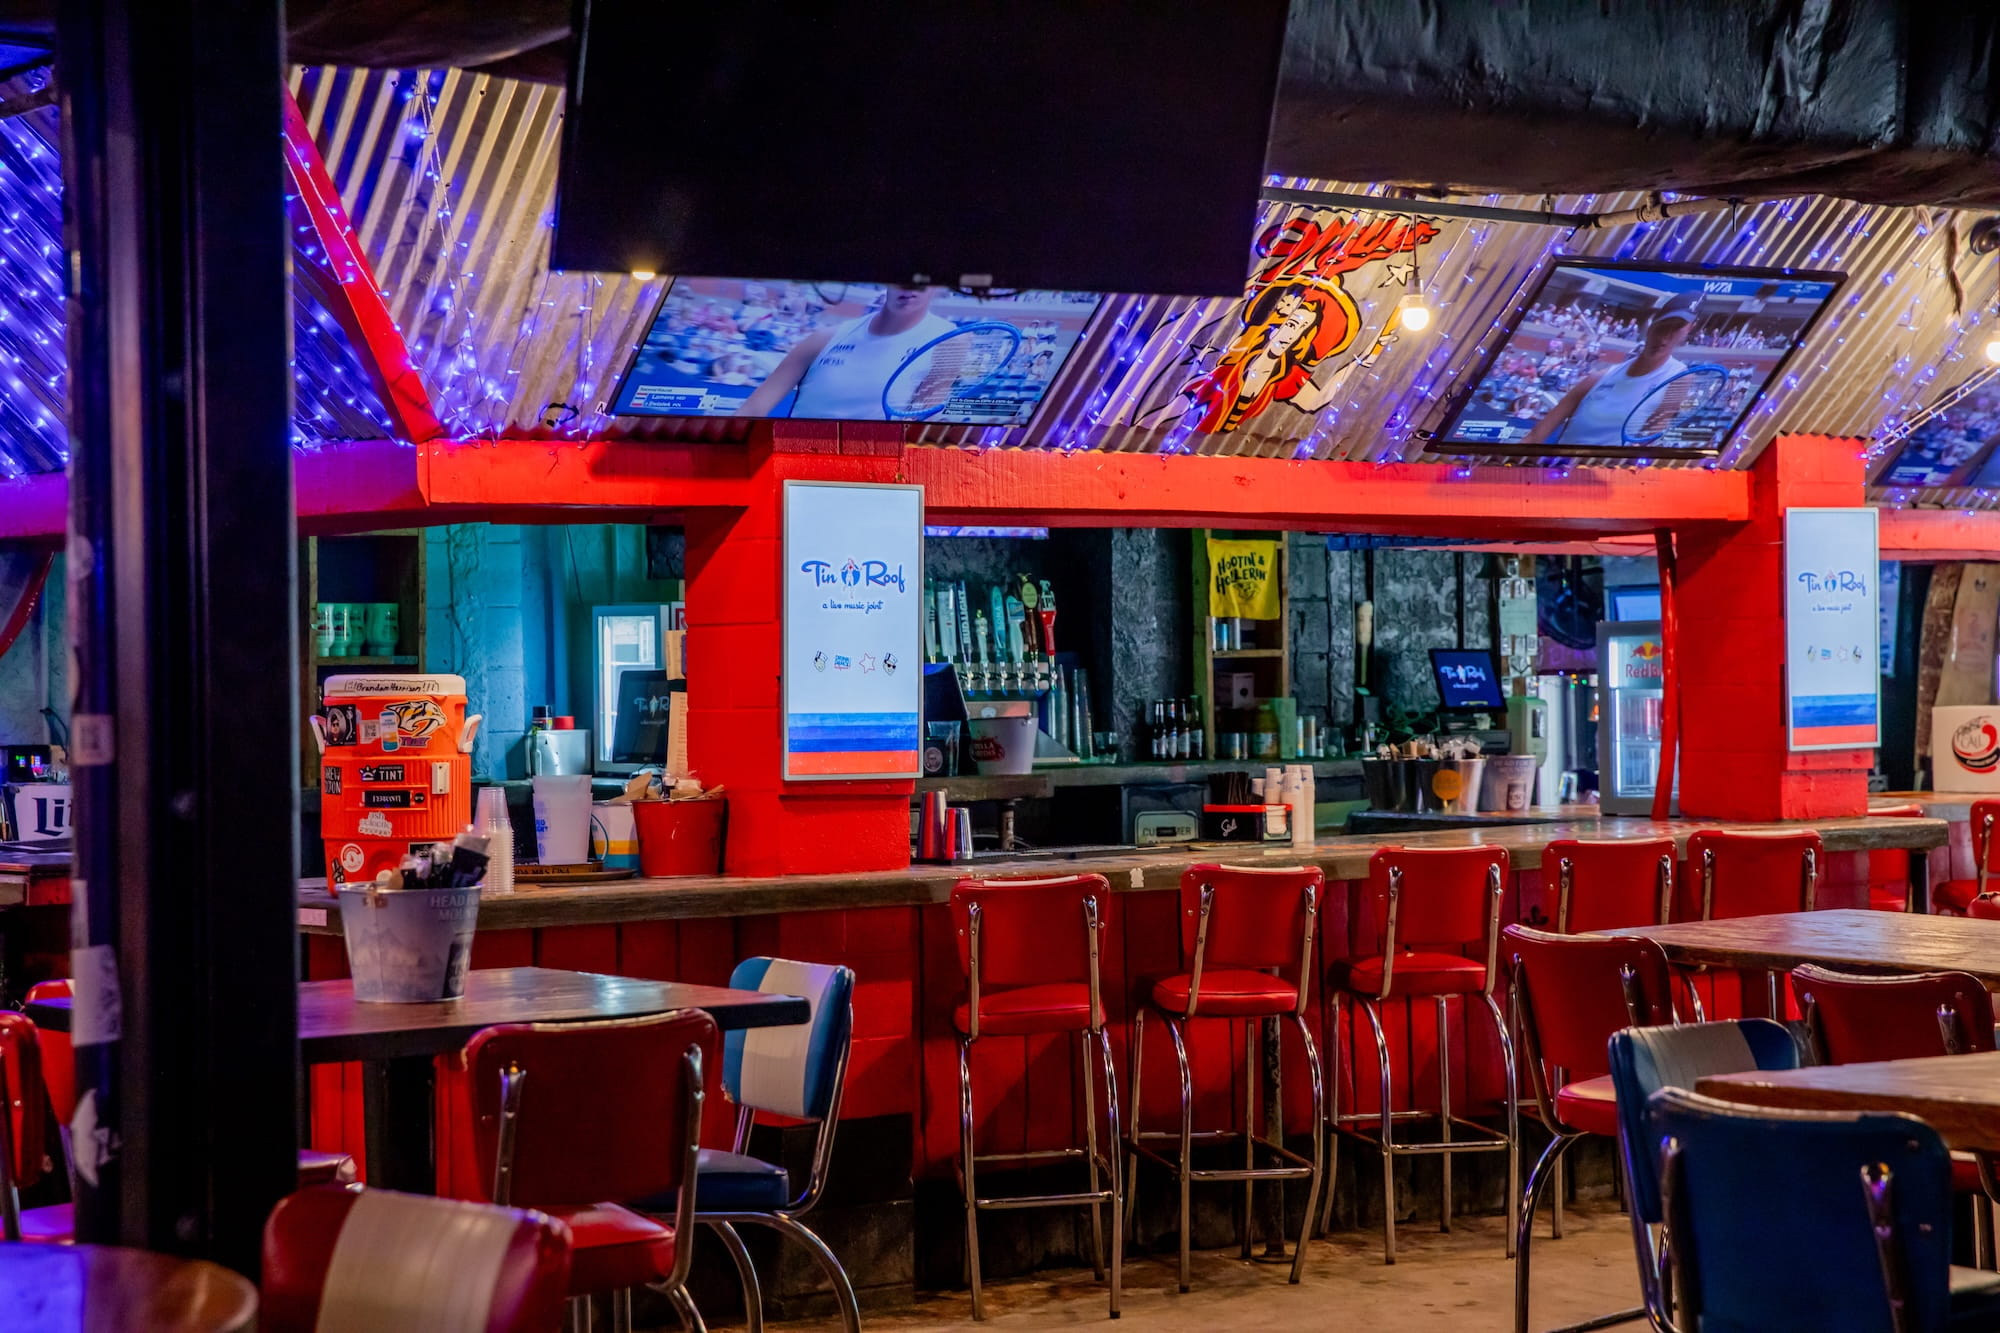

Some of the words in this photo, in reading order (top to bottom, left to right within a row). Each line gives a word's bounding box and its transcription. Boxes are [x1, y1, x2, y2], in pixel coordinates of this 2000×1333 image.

[1703, 281, 1733, 293] WTA
[801, 560, 838, 587] Tin
[862, 560, 906, 593] Roof
[1798, 572, 1822, 593] Tin
[1838, 571, 1866, 597] Roof
[830, 599, 842, 609] live
[844, 601, 865, 609] music
[865, 600, 884, 614] joint
[1625, 663, 1649, 678] Red
[379, 770, 403, 781] TINT
[32, 797, 73, 837] Li
[431, 895, 465, 908] HEAD
